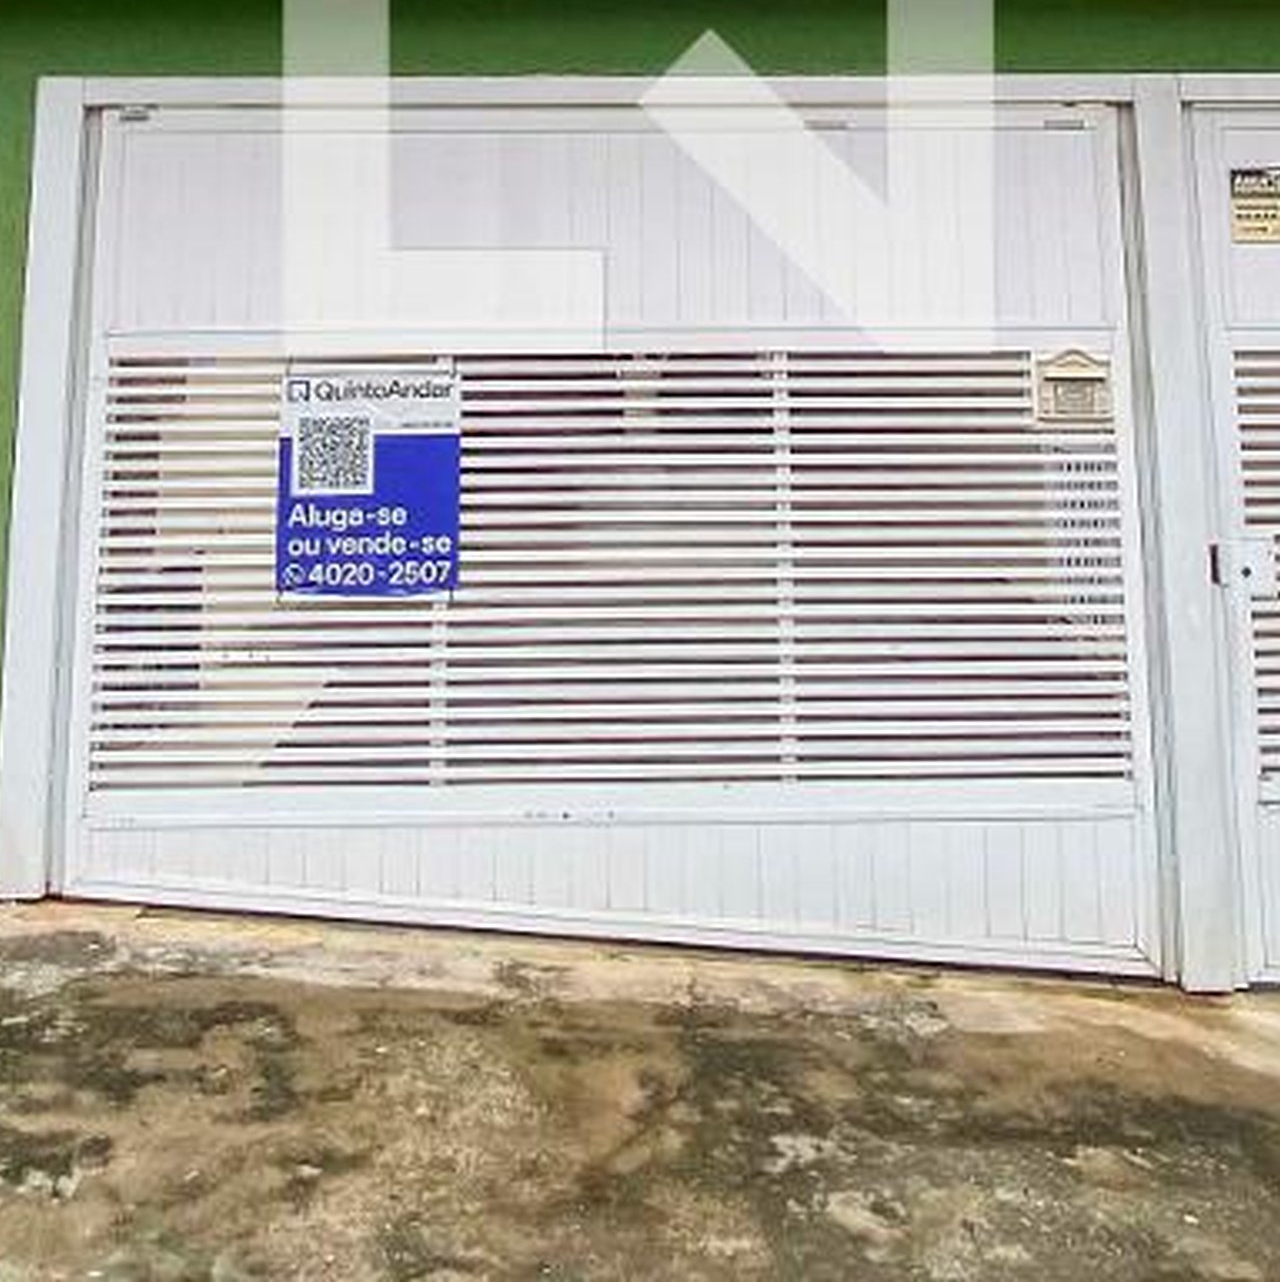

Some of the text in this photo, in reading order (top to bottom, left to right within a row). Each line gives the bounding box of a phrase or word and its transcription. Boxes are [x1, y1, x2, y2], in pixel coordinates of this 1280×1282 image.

[314, 381, 453, 400] QuintoAndar
[288, 504, 408, 532] Aluga-se
[288, 530, 453, 556] ou vende-se
[309, 561, 452, 585] 4020-2507
